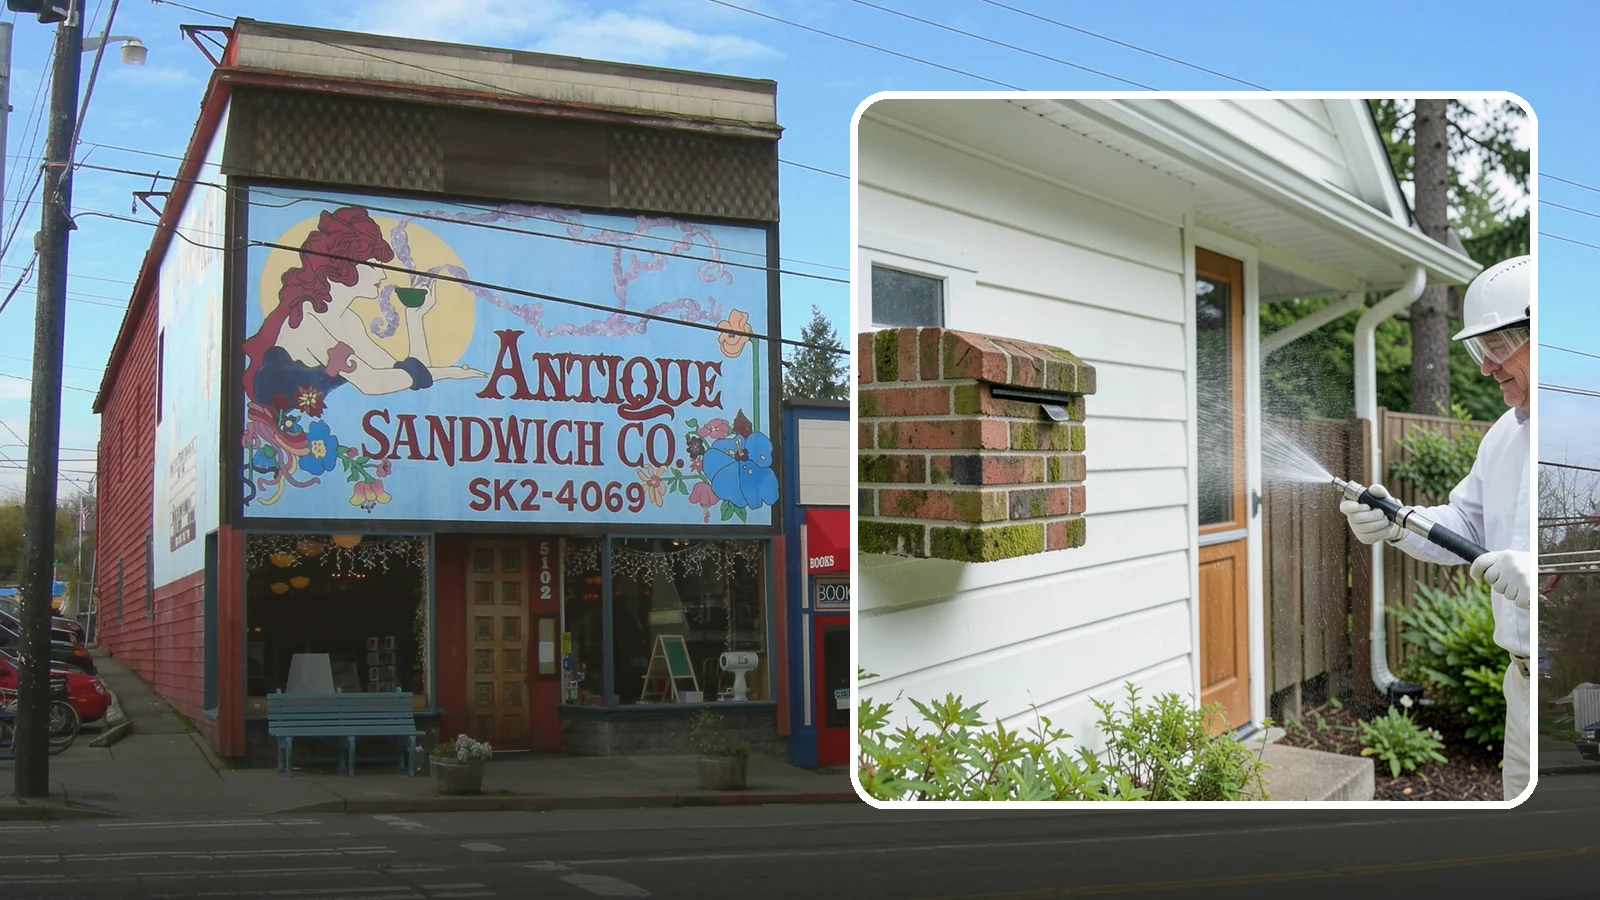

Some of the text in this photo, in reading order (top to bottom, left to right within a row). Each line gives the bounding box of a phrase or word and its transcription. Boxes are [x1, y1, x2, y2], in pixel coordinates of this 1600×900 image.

[476, 329, 724, 421] ANTIQUE
[361, 408, 685, 468] SANDWICH CO.
[469, 477, 646, 513] SK2-4069
[539, 541, 552, 600] 5102
[809, 554, 835, 569] BOOKS
